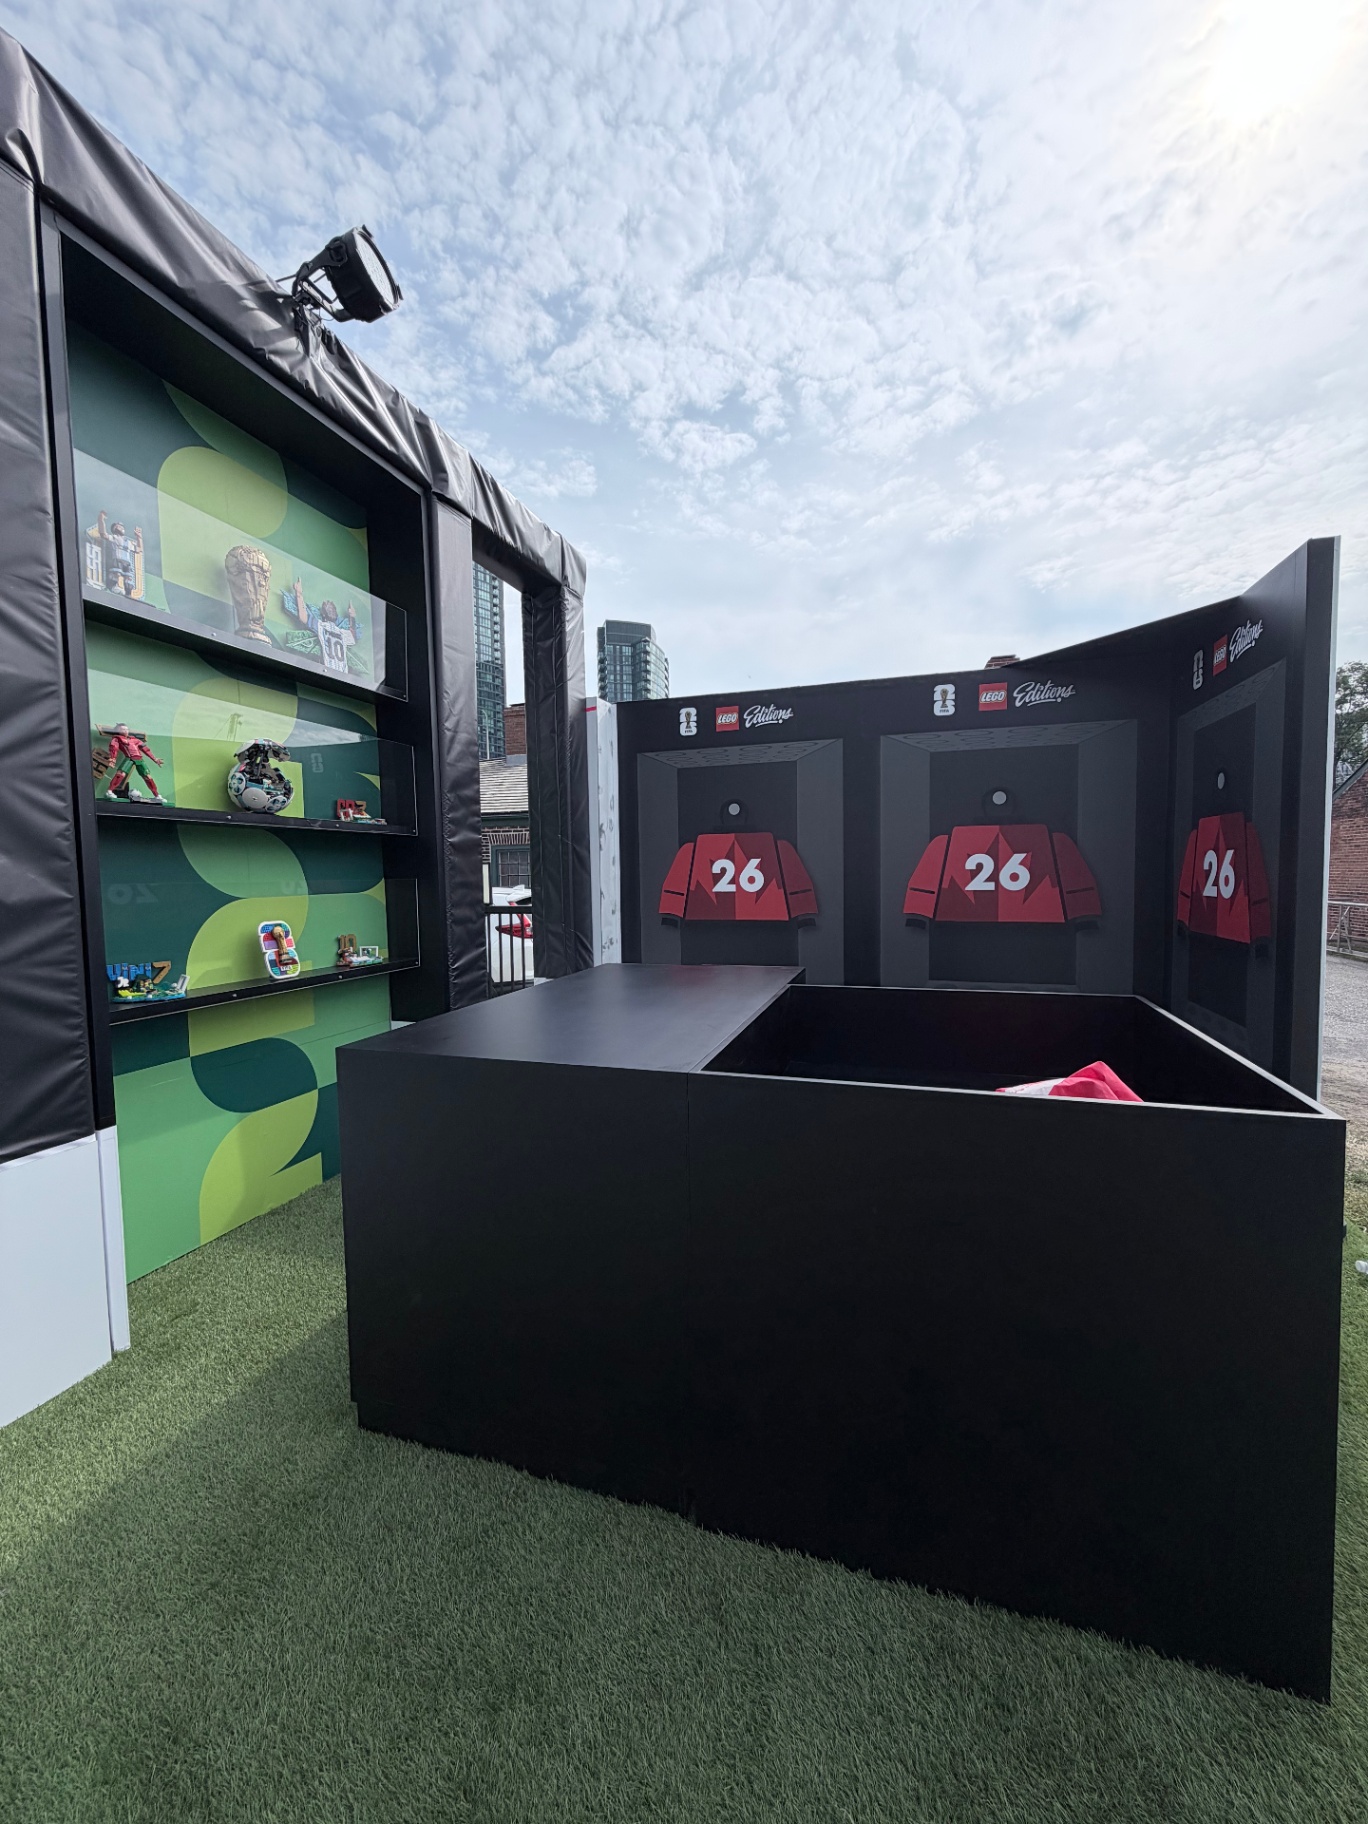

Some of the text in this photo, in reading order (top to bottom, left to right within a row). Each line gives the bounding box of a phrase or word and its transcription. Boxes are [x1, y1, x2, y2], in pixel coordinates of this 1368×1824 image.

[980, 680, 1075, 707] LEGO Editions
[717, 703, 793, 729] LEGO Editions
[711, 858, 765, 893] 26
[964, 852, 1031, 891] 26
[1202, 849, 1236, 900] 26
